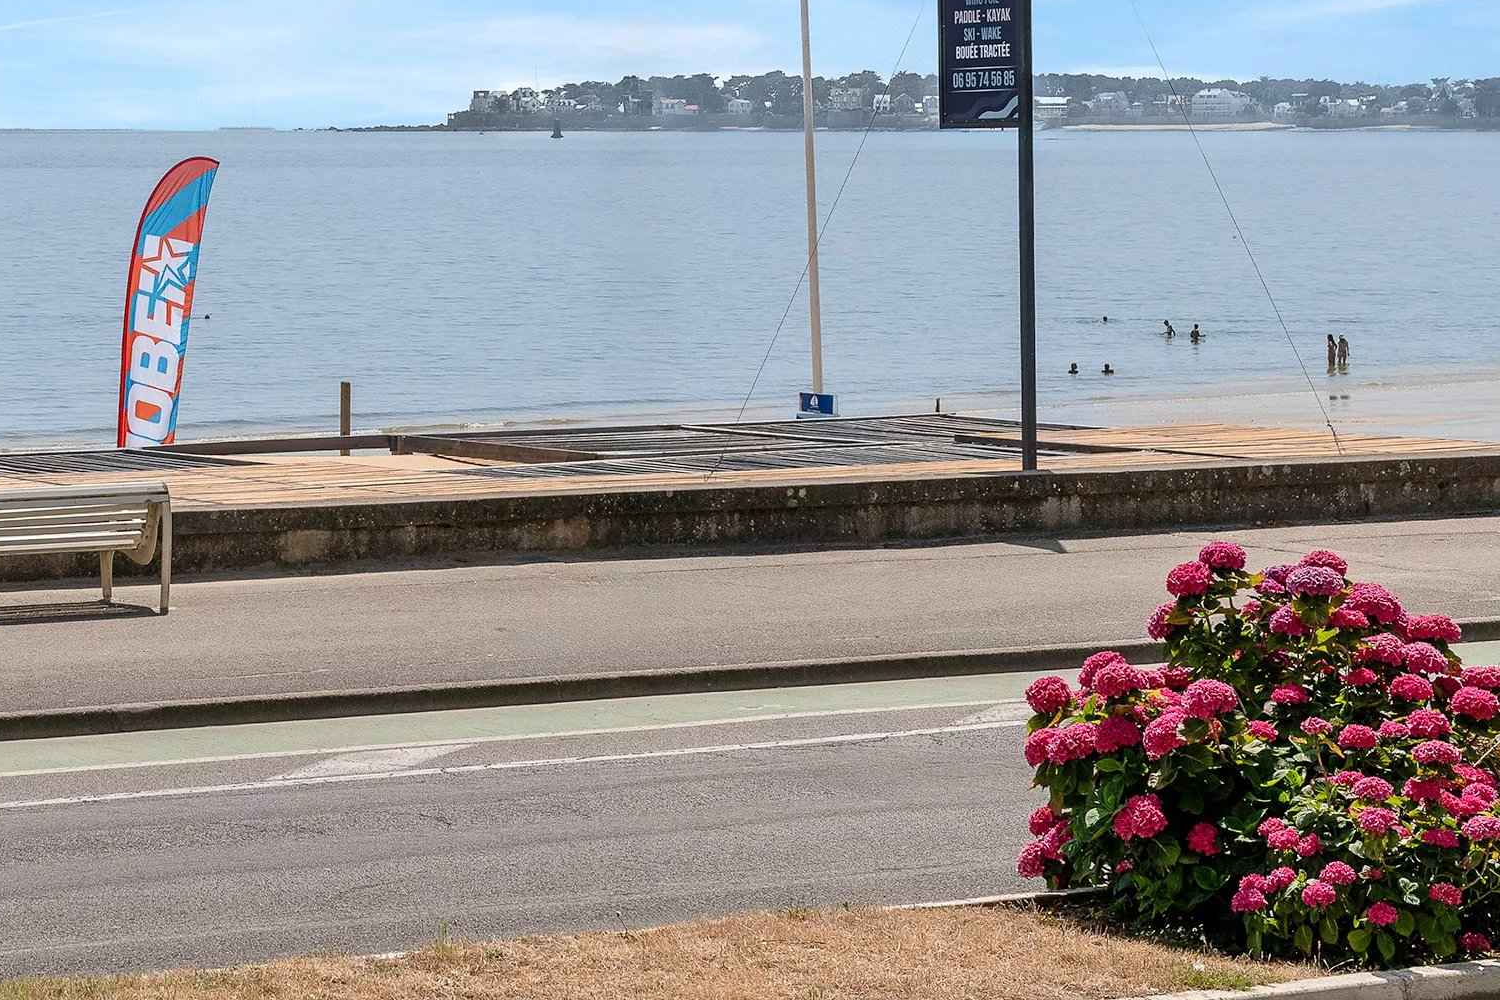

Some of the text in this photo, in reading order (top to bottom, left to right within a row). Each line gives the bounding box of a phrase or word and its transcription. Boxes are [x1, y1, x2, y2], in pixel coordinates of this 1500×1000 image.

[954, 9, 981, 25] PADDLE
[986, 7, 1011, 23] KAYAK
[963, 27, 976, 41] SKI
[980, 26, 1002, 41] WAKE
[955, 40, 1011, 60] BOUÉE TRACTÉE
[952, 70, 1015, 88] 06 95 74 56 85
[125, 291, 184, 447] OBE
